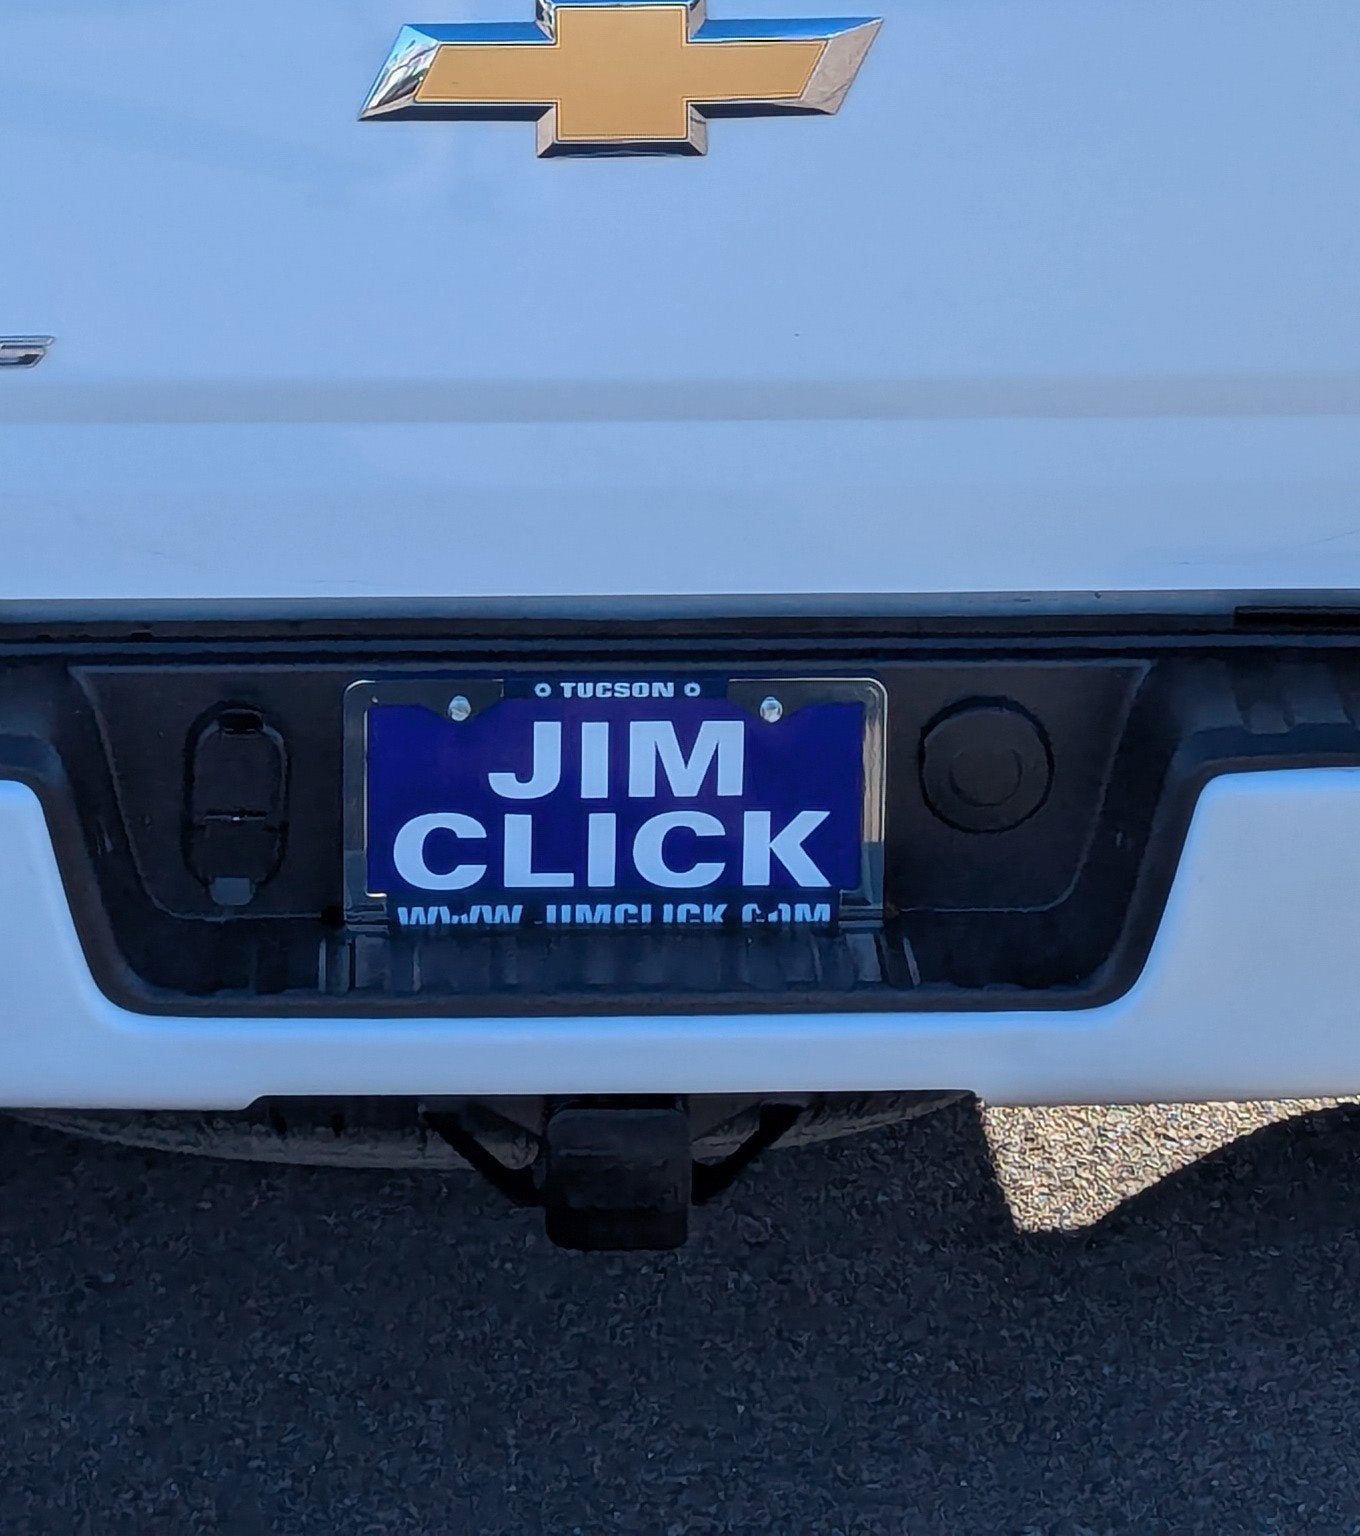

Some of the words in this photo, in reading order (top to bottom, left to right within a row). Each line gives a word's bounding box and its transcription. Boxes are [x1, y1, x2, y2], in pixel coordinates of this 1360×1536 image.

[560, 682, 675, 698] TUCSON
[487, 719, 745, 800] JIM
[392, 809, 832, 891] CLICK
